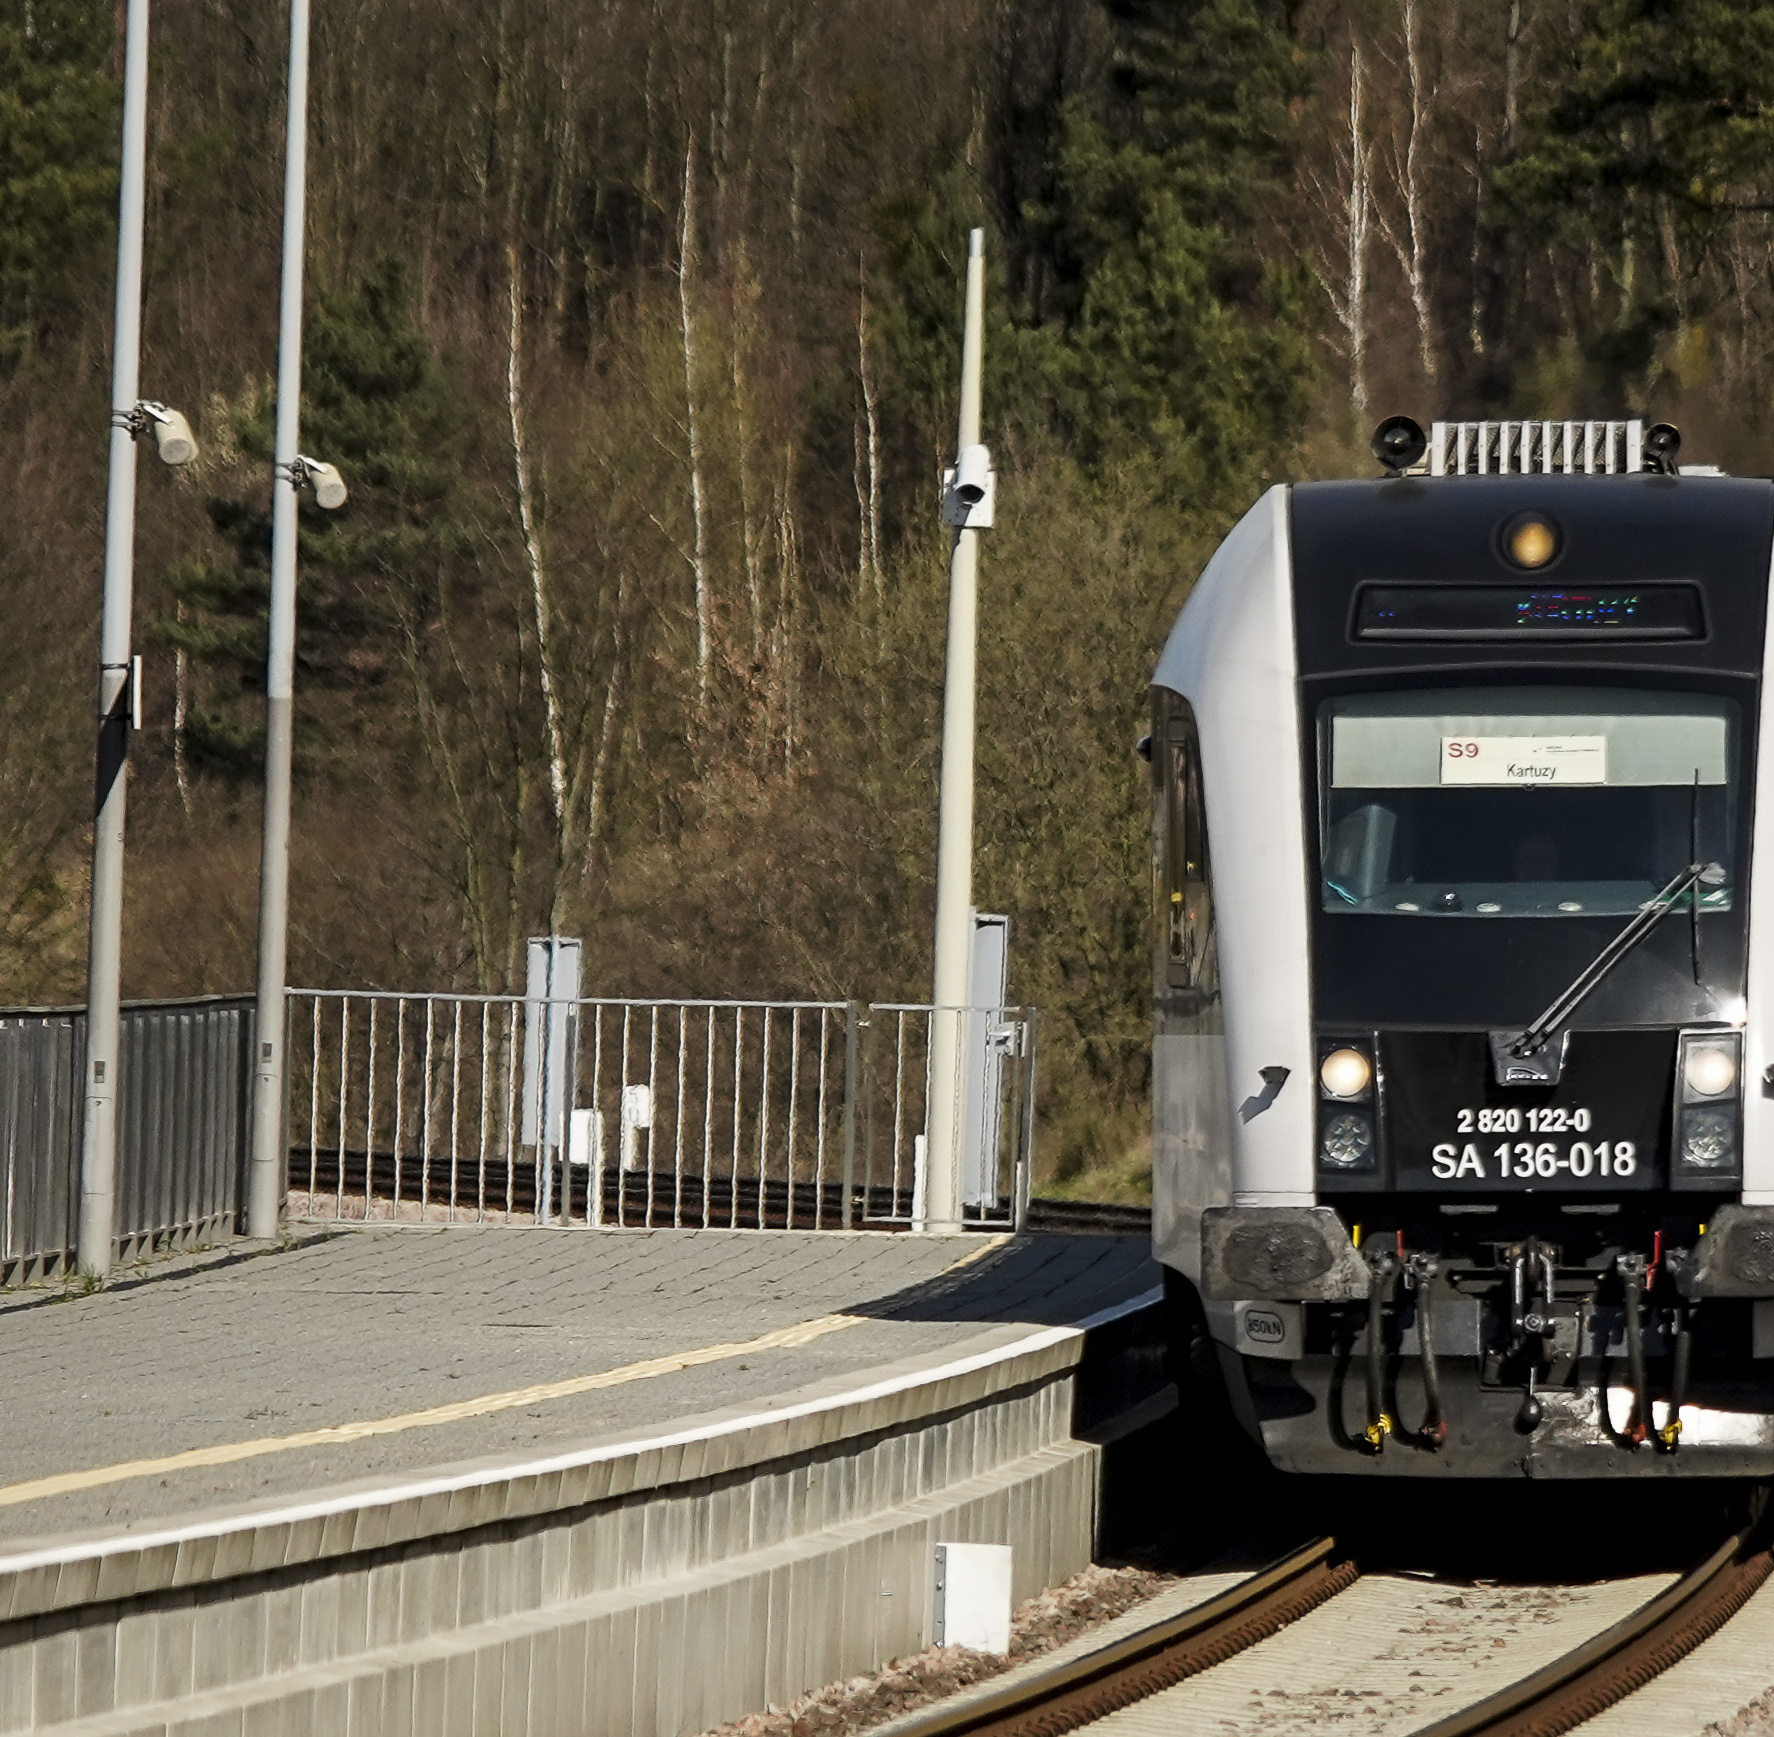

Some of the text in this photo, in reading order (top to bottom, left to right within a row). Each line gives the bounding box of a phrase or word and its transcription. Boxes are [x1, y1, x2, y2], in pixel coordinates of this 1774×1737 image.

[1447, 742, 1479, 759] S9
[1506, 763, 1556, 780] Kartuzy
[1457, 1108, 1592, 1133] 2 820 122-0
[1432, 1141, 1637, 1179] SA 136-018
